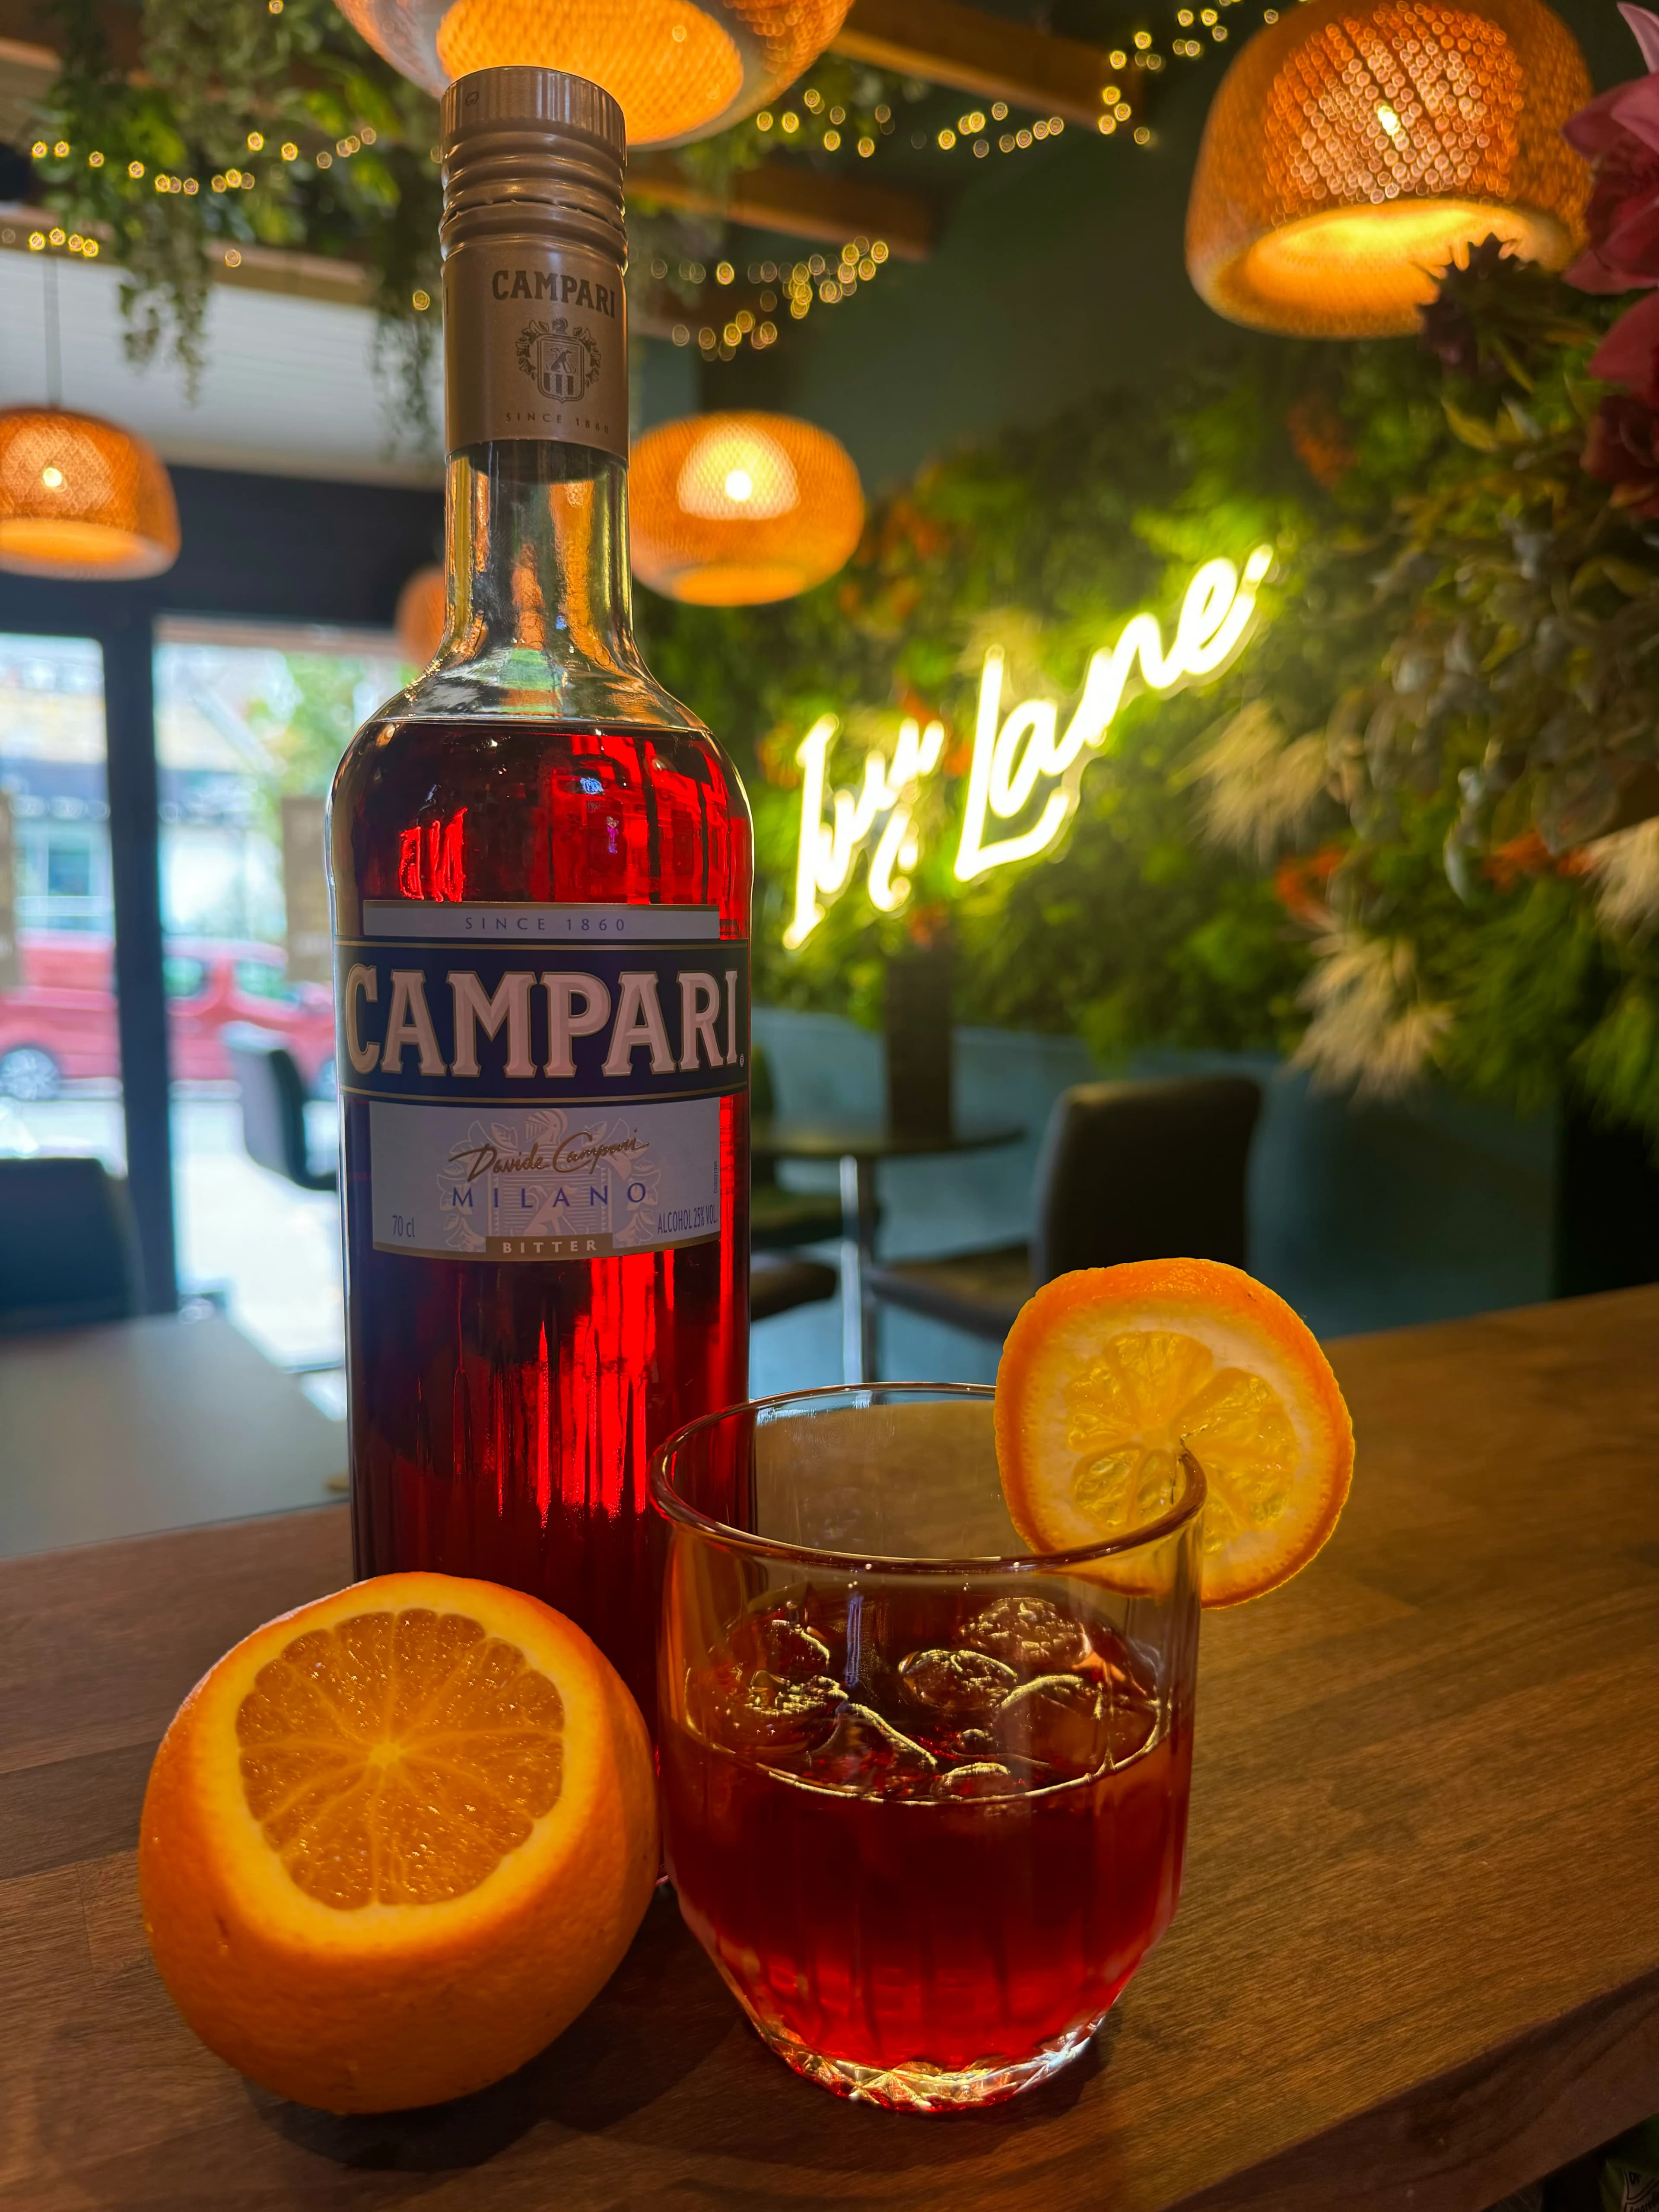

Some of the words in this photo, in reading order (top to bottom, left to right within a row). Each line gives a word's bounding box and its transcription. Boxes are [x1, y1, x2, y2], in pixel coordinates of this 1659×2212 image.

[492, 270, 616, 318] CAMPARI
[506, 413, 562, 424] SINCE
[575, 417, 609, 434] 1860
[953, 543, 1274, 882] Lane
[465, 917, 545, 930] SINCE
[566, 918, 624, 931] 1860
[345, 963, 738, 1078] CAMPARI
[448, 1143, 551, 1183] Davide
[553, 1127, 650, 1174] Campari
[452, 1182, 646, 1208] MILANO
[392, 1214, 403, 1236] 70
[407, 1216, 415, 1238] cl
[658, 1208, 692, 1234] ALCOHOL
[694, 1206, 705, 1228] 25%
[706, 1204, 718, 1225] VOL.
[502, 1239, 597, 1253] BITTER
